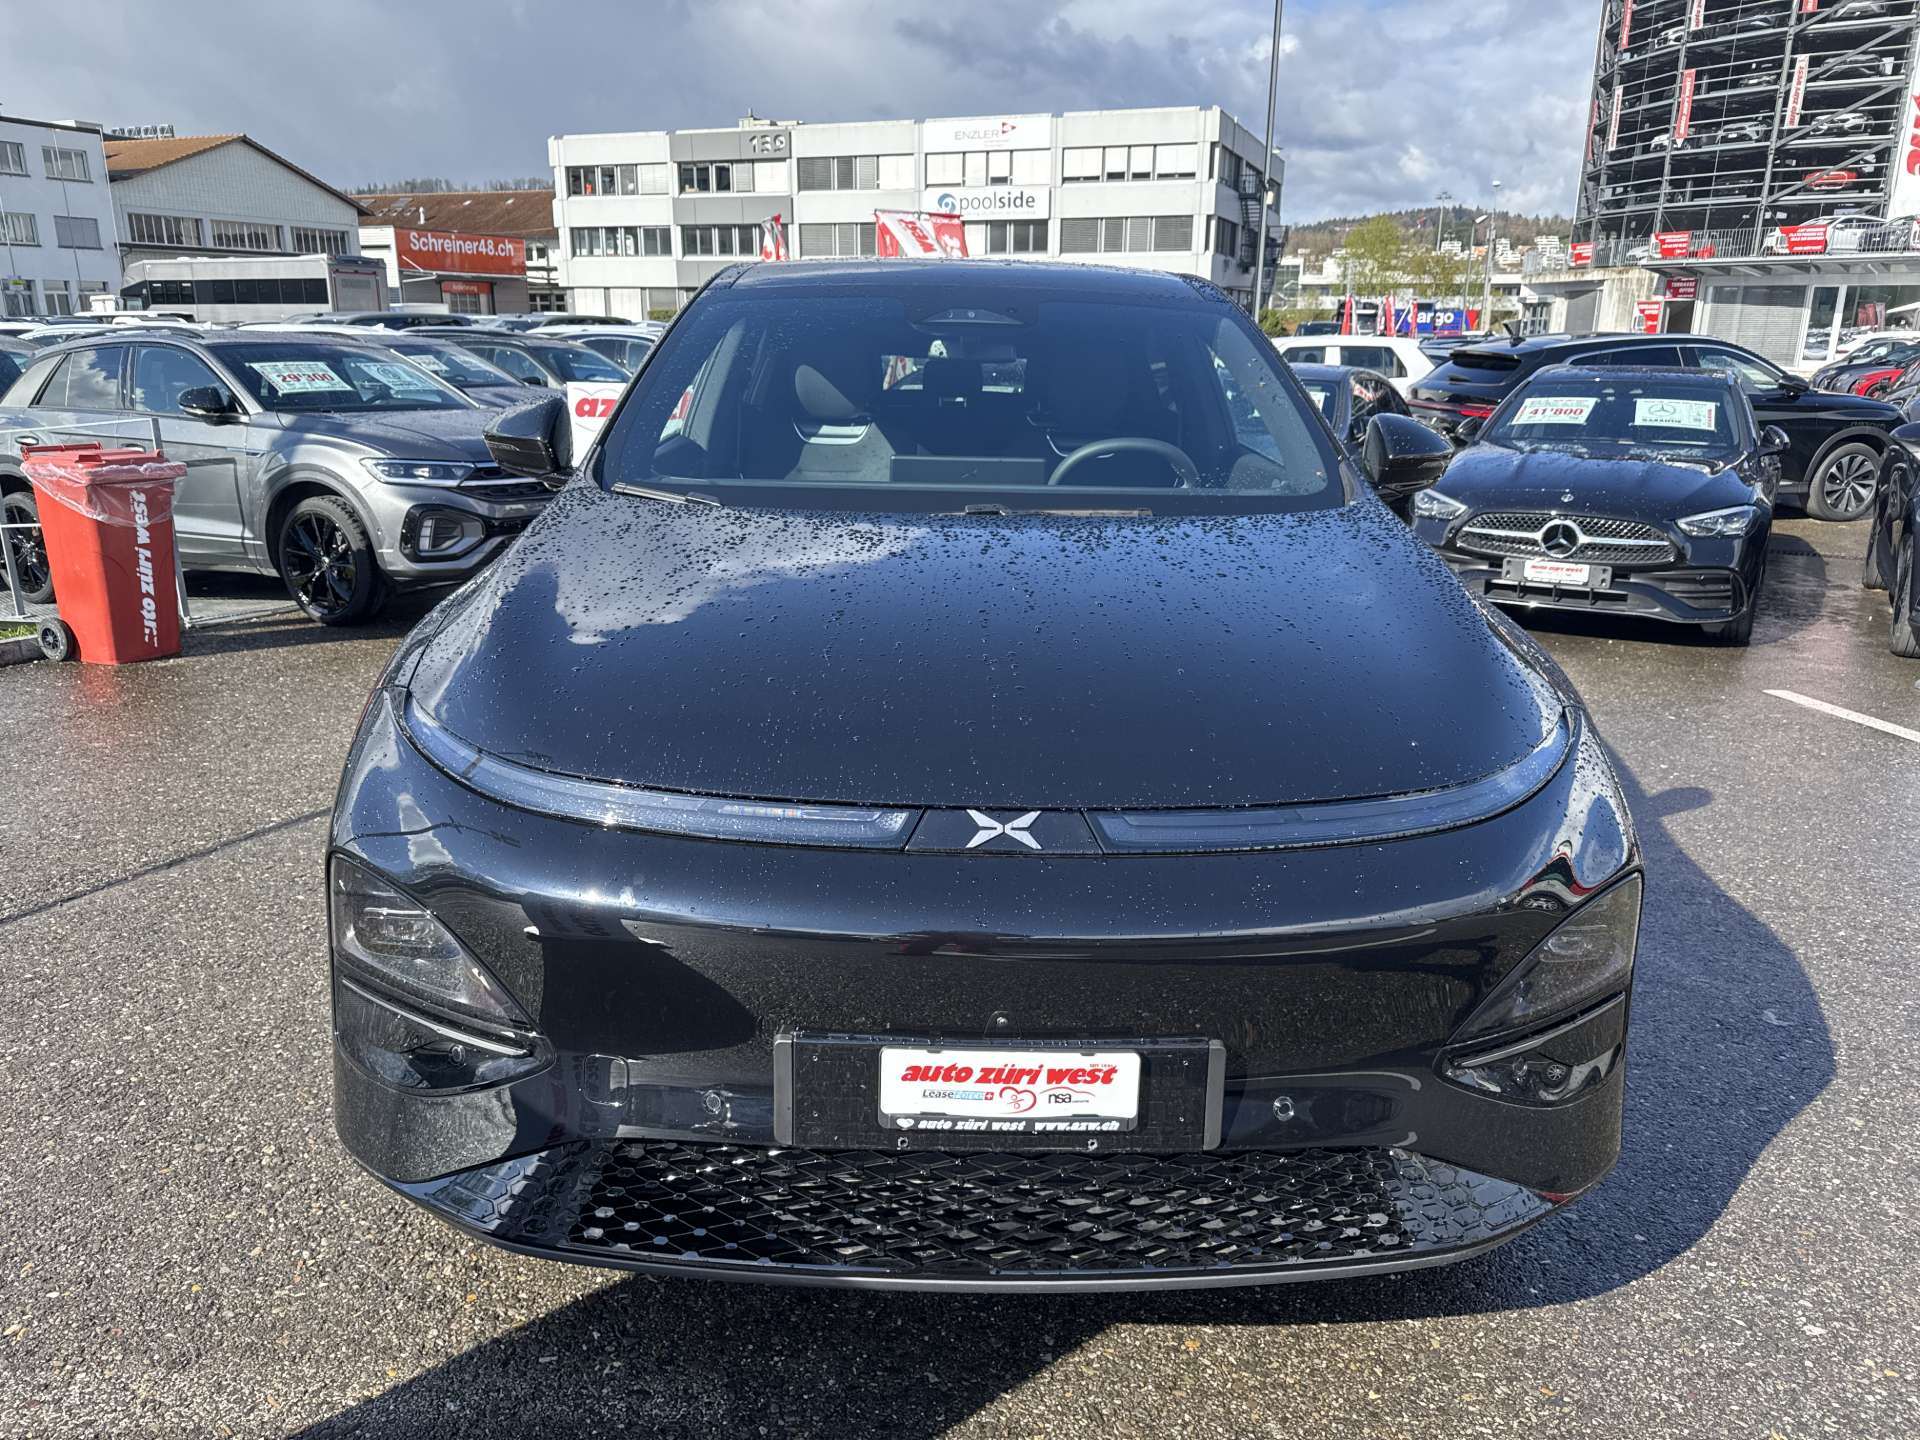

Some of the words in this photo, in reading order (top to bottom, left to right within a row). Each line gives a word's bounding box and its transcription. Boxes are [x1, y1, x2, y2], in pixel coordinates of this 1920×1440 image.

[954, 129, 999, 140] ENZLER
[960, 190, 1036, 215] poolside
[409, 232, 514, 257] Schreiner48.ch
[575, 397, 617, 418] az
[1529, 407, 1584, 416] 41'800
[134, 546, 155, 596] züri
[901, 1062, 974, 1083] auto
[975, 1063, 1043, 1085] züri
[1046, 1065, 1119, 1085] west
[1048, 1093, 1072, 1104] nsa
[917, 1119, 952, 1130] auto
[955, 1119, 989, 1131] züri
[991, 1120, 1026, 1131] west
[1034, 1120, 1120, 1131] www.azw.ch
